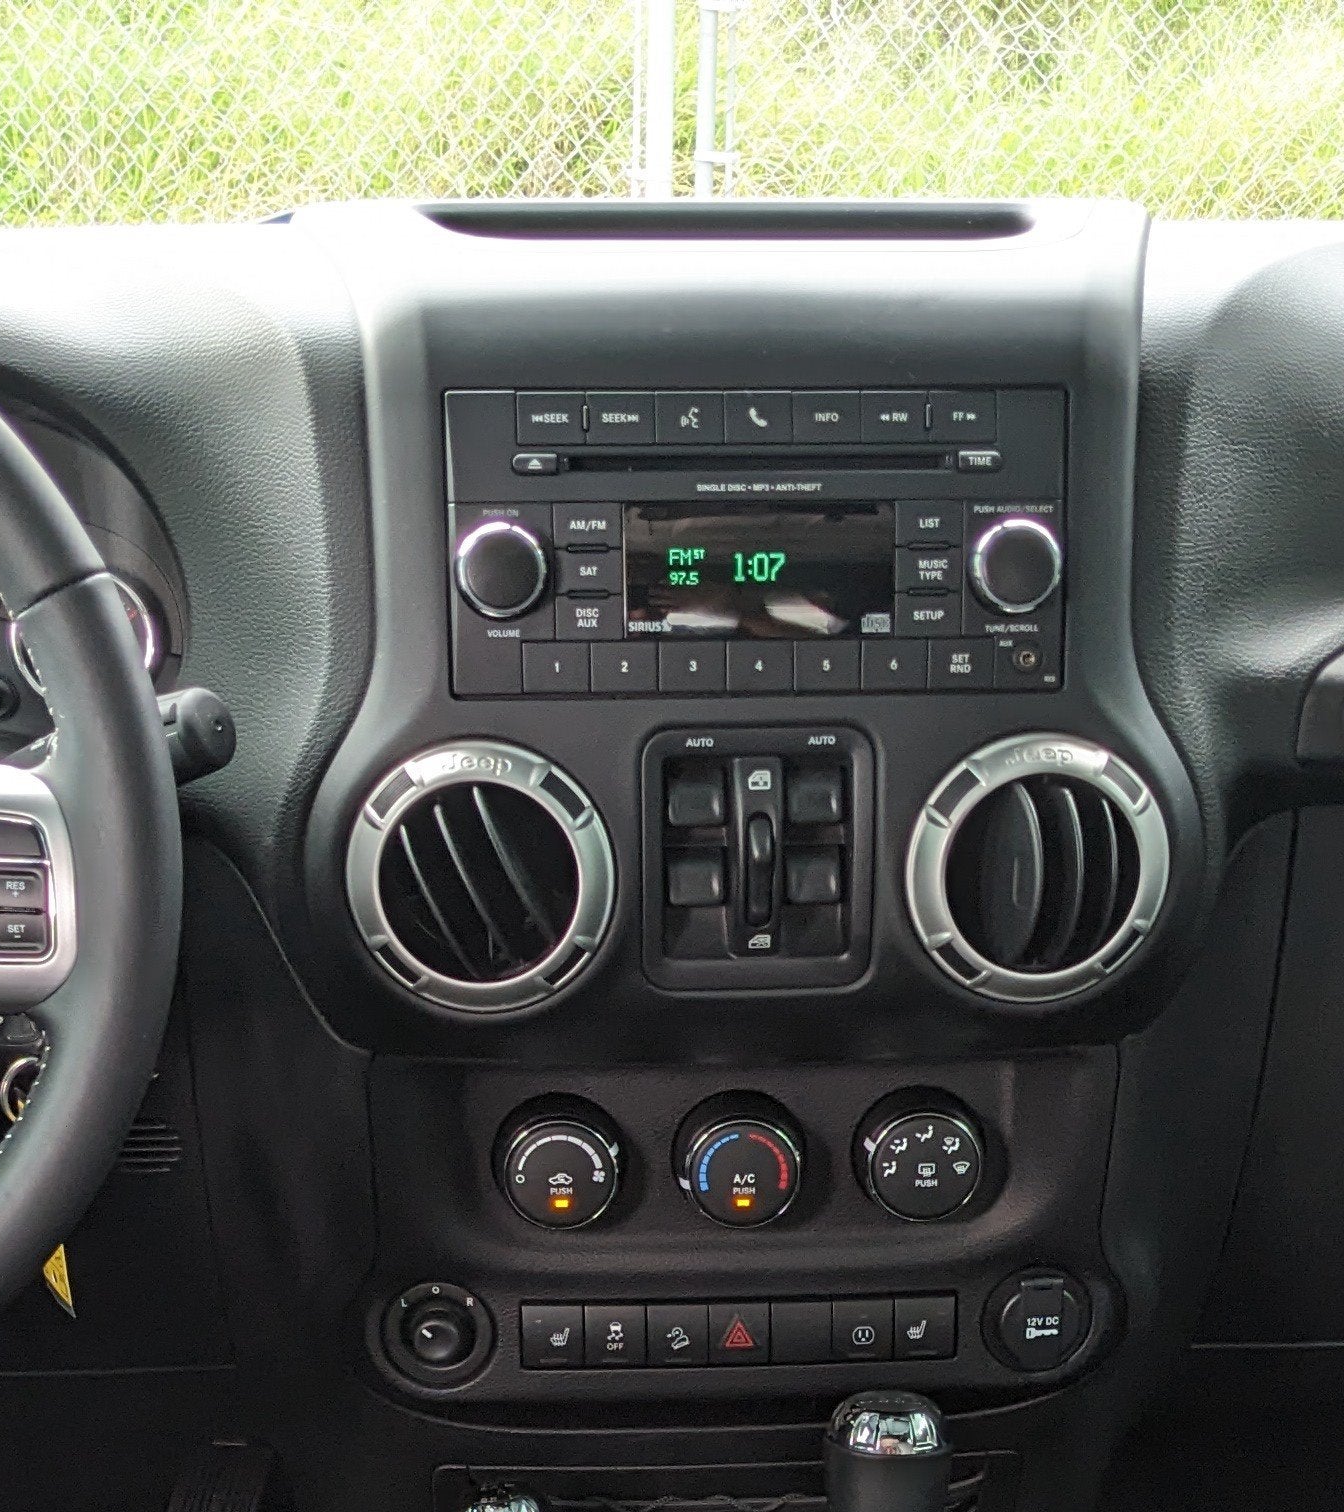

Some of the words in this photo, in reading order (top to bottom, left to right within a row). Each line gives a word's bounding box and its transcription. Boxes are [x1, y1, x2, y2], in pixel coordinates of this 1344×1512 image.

[543, 413, 568, 423] SEEK
[602, 413, 627, 423] SEEK
[815, 412, 838, 422] INFO
[892, 412, 908, 422] RW
[952, 411, 965, 421] FF
[968, 456, 992, 466] TIME
[697, 484, 726, 492] SINGLE
[728, 484, 746, 492] DISC
[752, 484, 770, 492] MP3
[775, 483, 822, 492] ANTI-THEFT
[482, 509, 505, 517] PUSH
[507, 509, 519, 517] ON
[974, 505, 995, 513] PUSH
[569, 520, 606, 531] AM/FM
[919, 519, 940, 528] LIST
[669, 549, 692, 566] FM
[734, 553, 787, 582] 1:07
[919, 559, 948, 569] MUSIC
[579, 567, 598, 576] SAT
[919, 571, 943, 580] TYPE
[669, 572, 699, 586] 97.5
[576, 609, 599, 618] DISC
[913, 611, 944, 621] SETUP
[577, 618, 598, 628] AUX
[628, 621, 661, 633] SIRIUS
[487, 629, 520, 638] VOLUME
[952, 654, 969, 663] SET
[554, 661, 560, 673] 1
[621, 661, 628, 673] 2
[689, 660, 697, 672] 3
[755, 660, 763, 672] 4
[822, 660, 830, 671] 5
[890, 659, 898, 671] 6
[950, 664, 971, 673] RND
[685, 738, 714, 748] AUTO
[808, 735, 836, 746] AUTO
[442, 753, 512, 776] Jeep
[6, 881, 25, 891] RES
[7, 924, 25, 934] SET
[733, 1173, 755, 1184] A/C
[915, 1179, 938, 1187] PUSH
[550, 1187, 573, 1195] PUSH
[733, 1187, 756, 1195] PUSH
[401, 1298, 407, 1308] L
[466, 1297, 474, 1306] R
[1026, 1318, 1043, 1326] 12V
[1046, 1316, 1060, 1326] DC
[607, 1342, 624, 1351] OFF
